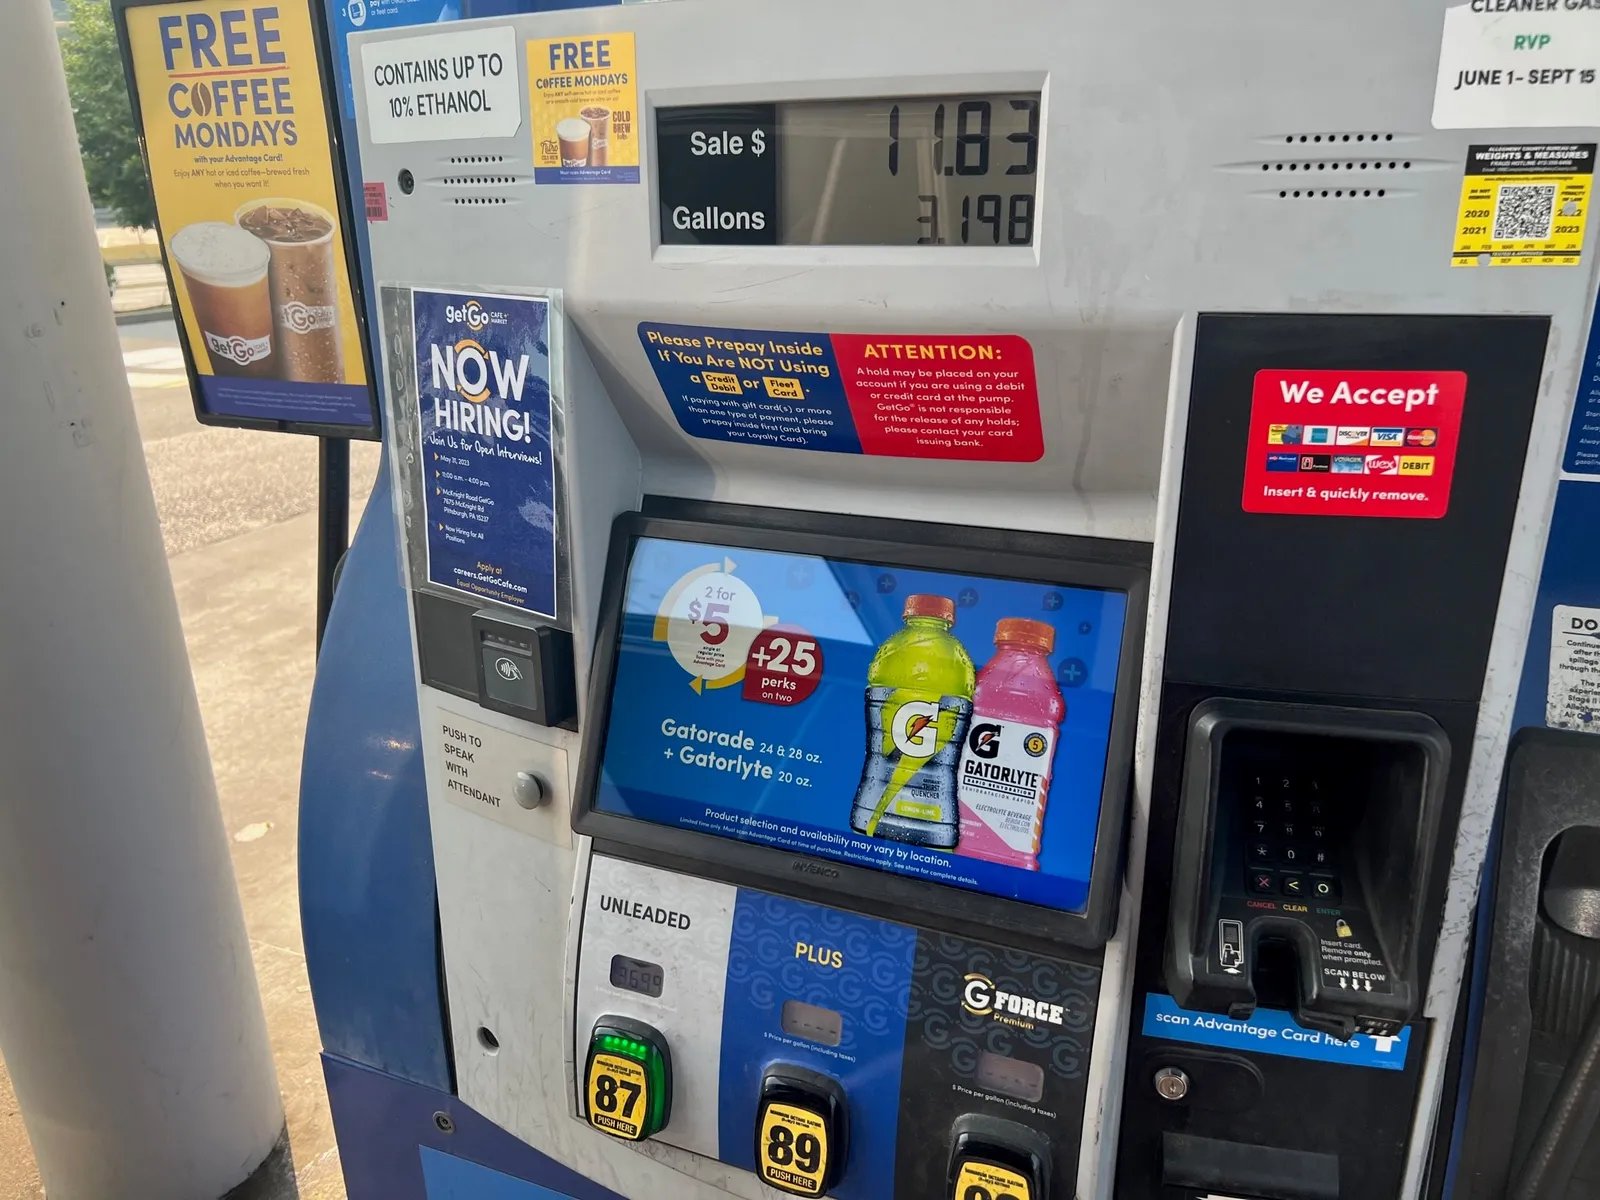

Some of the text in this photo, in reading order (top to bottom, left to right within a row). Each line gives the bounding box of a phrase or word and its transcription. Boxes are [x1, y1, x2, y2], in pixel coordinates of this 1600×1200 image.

[1470, 0, 1558, 12] CLEANER
[159, 7, 286, 70] FREE
[1514, 34, 1551, 50] RVP
[550, 40, 610, 70] FREE
[374, 53, 502, 86] CONTAINS UP TO
[1454, 70, 1502, 90] JUNE
[1528, 69, 1574, 84] SEPT
[1579, 69, 1596, 83] 15
[536, 74, 628, 89] COFFEE MONDAYS
[389, 90, 491, 118] 10% ETHANOL
[612, 111, 630, 122] COLD
[175, 120, 297, 149] MONDAYS
[613, 124, 630, 133] BREW
[888, 100, 1039, 176] 11.83
[690, 128, 765, 157] Sale $
[194, 153, 283, 164] with your Advantage Card!
[1476, 152, 1521, 160] WEIGHTS
[1534, 151, 1589, 159] MEASURES
[672, 206, 765, 230] Gallons
[917, 194, 1033, 244] 3.198
[1464, 210, 1490, 218] 2020
[446, 304, 488, 326] getGo
[211, 337, 254, 365] getGo
[646, 331, 823, 356] Please Prepay Inside
[864, 344, 1002, 360] ATTENTION:
[430, 343, 530, 401] NOW
[658, 350, 830, 378] If You Are NOT Using
[866, 367, 889, 376] hold
[893, 370, 916, 378] may
[918, 368, 932, 378] be
[936, 369, 973, 380] placed
[690, 374, 794, 389] a Credit or Fleet
[711, 383, 798, 398] Debit Card
[1280, 380, 1439, 412] We Accept
[434, 398, 531, 444] HIRING!
[916, 437, 984, 447] issuing bank.
[1377, 432, 1398, 440] VISA
[428, 431, 543, 466] Join Us for Open Interviews!
[1402, 462, 1430, 470] DEBIT
[1264, 486, 1428, 502] Insert & quickly remove.
[469, 512, 476, 520] PA
[476, 560, 502, 575] Apply at
[454, 565, 528, 594] careers.GetGoCafe.com
[456, 578, 525, 605] Equal Opportunity Employer
[705, 586, 736, 600] 2 for
[688, 598, 730, 645] $5
[1572, 618, 1598, 630] DO
[751, 638, 816, 676] +25
[1569, 657, 1598, 666] spillage
[1560, 664, 1589, 672] through
[761, 677, 796, 690] perks
[762, 690, 792, 702] on two
[443, 725, 482, 748] PUSH TO
[891, 701, 940, 758] G
[661, 718, 822, 764] Gatorade 24 & 28 oz.
[970, 723, 1038, 758] G 5
[444, 744, 475, 763] SPEAK
[446, 760, 468, 778] WITH
[664, 746, 812, 787] + Gatorlyte 20 oz.
[965, 760, 1038, 788] GATORLYTE
[448, 779, 501, 808] ATTENDANT
[705, 808, 952, 868] Product selection and availability may vary by location.
[600, 895, 691, 930] UNLEADED
[1247, 900, 1340, 916] CANCEL CLEAR ENTER
[1321, 940, 1343, 948] Insert
[1321, 947, 1371, 958] Remove only
[796, 942, 842, 968] PLUS
[1322, 954, 1383, 966] when prompted.
[1324, 968, 1385, 980] SCAN BELOW
[964, 980, 1064, 1024] G FORCE
[994, 1014, 1034, 1030] Premium
[1156, 1014, 1192, 1026] scan
[1195, 1016, 1277, 1039] Advantage
[1281, 1028, 1320, 1044] Card
[595, 1074, 642, 1119] 87
[598, 1116, 634, 1134] PUSH HERE
[768, 1125, 820, 1174] 89
[770, 1168, 813, 1188] PUSH HERE
